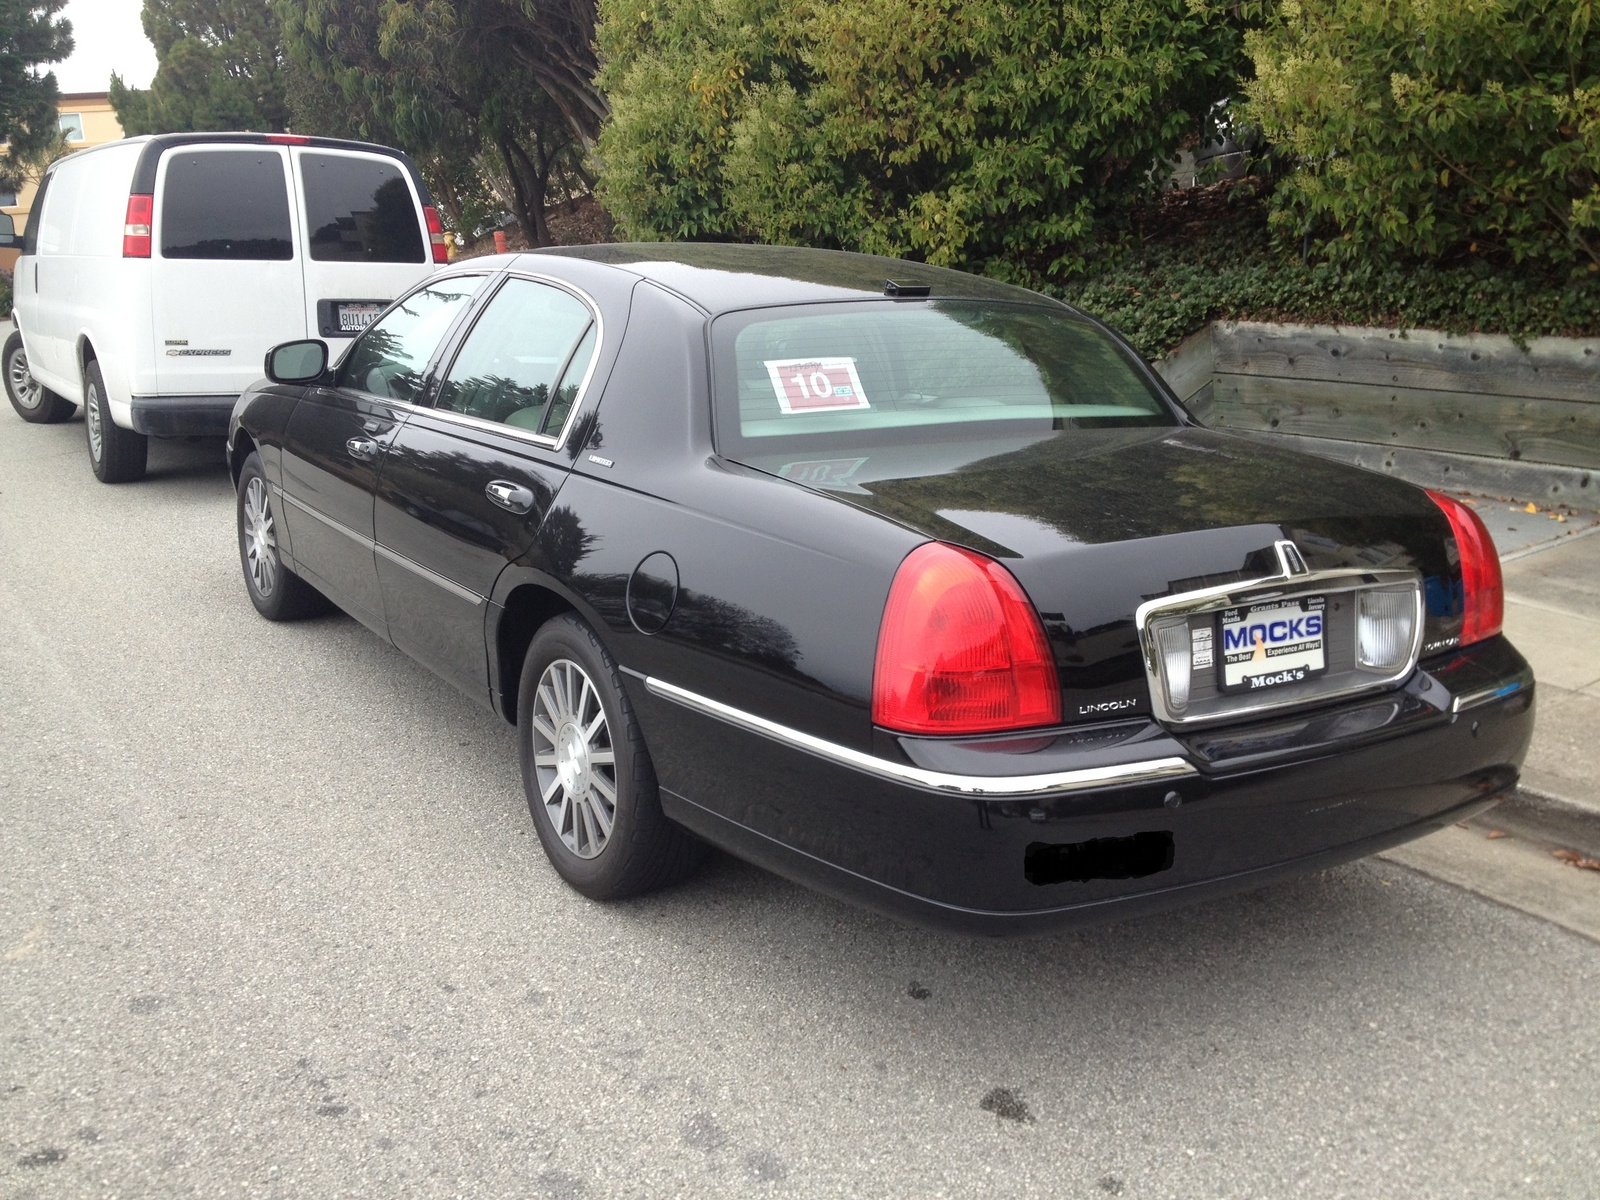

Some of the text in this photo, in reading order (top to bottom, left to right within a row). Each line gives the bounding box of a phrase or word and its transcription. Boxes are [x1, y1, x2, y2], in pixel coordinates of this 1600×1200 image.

[179, 349, 232, 357] EXPRESS
[790, 371, 833, 399] 10
[1224, 609, 1238, 617] Ford
[1250, 600, 1300, 613] Grants Pass
[1224, 615, 1322, 650] MOCKS
[1226, 655, 1238, 663] The
[1238, 652, 1251, 661] Best
[1267, 645, 1298, 656] Experience
[1305, 640, 1320, 650] Ways!
[1250, 670, 1305, 688] Mock's
[1079, 698, 1137, 714] LINCOLN
